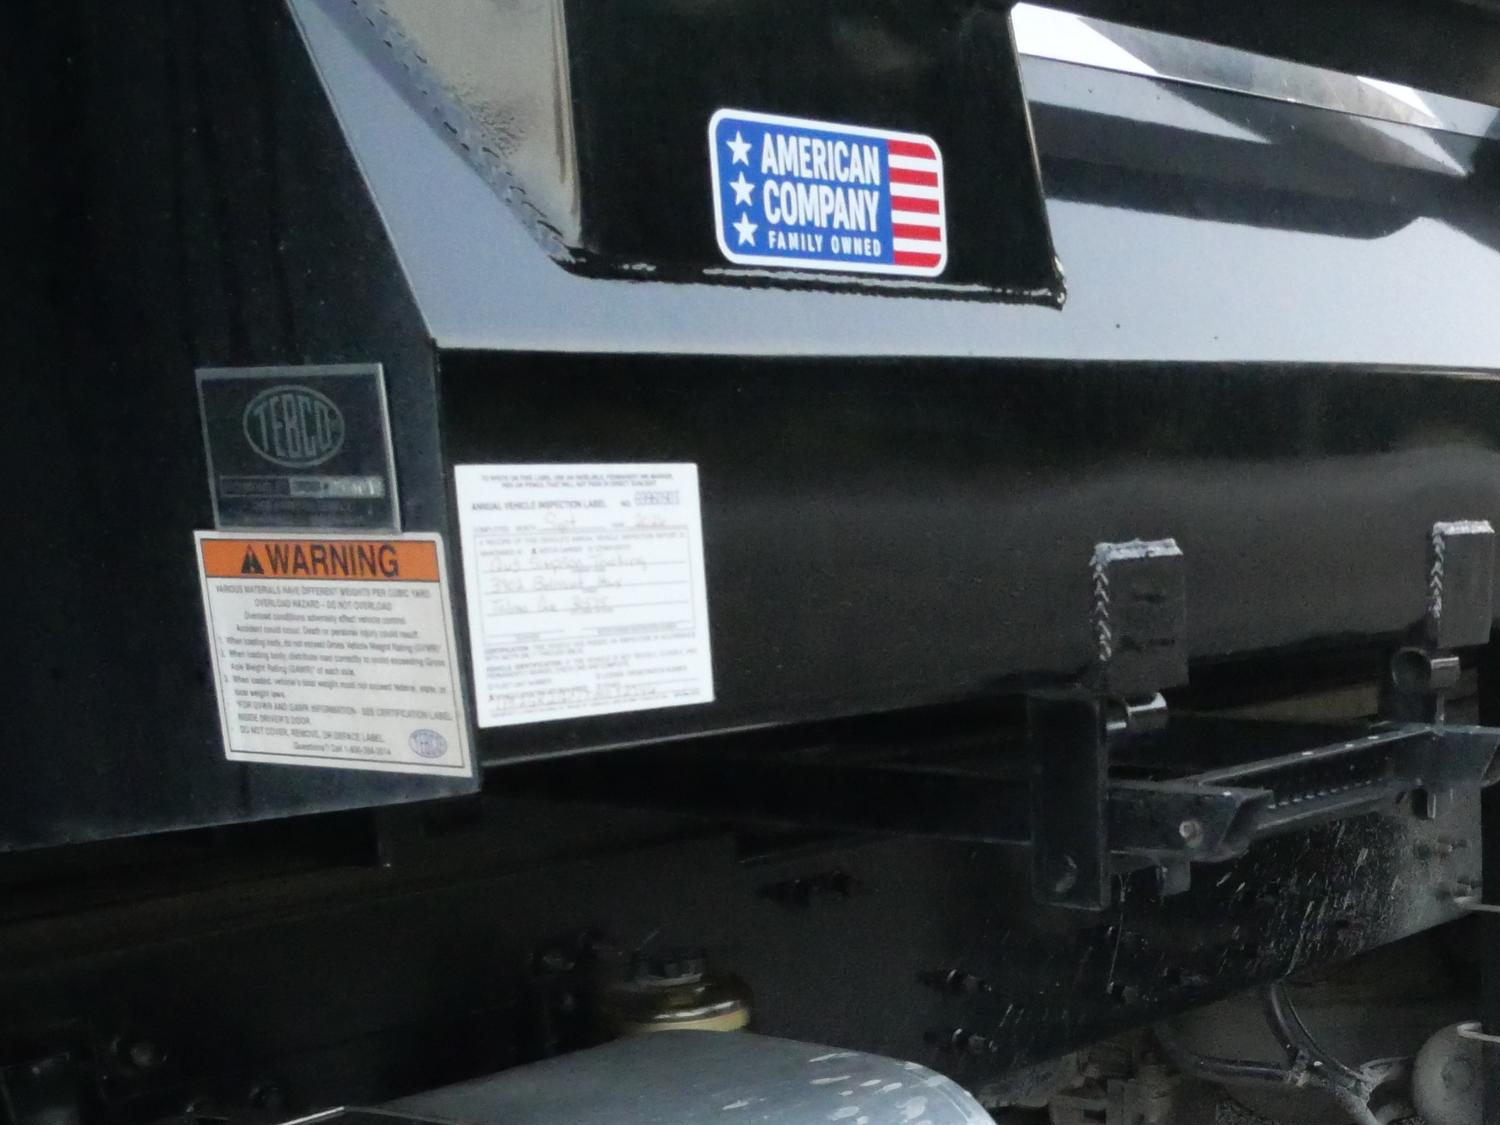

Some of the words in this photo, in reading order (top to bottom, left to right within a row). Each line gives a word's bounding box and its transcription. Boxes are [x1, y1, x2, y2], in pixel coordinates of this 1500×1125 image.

[761, 132, 880, 187] AMERICAN
[763, 180, 879, 232] COMPANY
[768, 231, 823, 254] FAMILY
[831, 236, 882, 257] OWNED
[252, 393, 333, 459] TEBCO
[265, 543, 400, 577] WARNING
